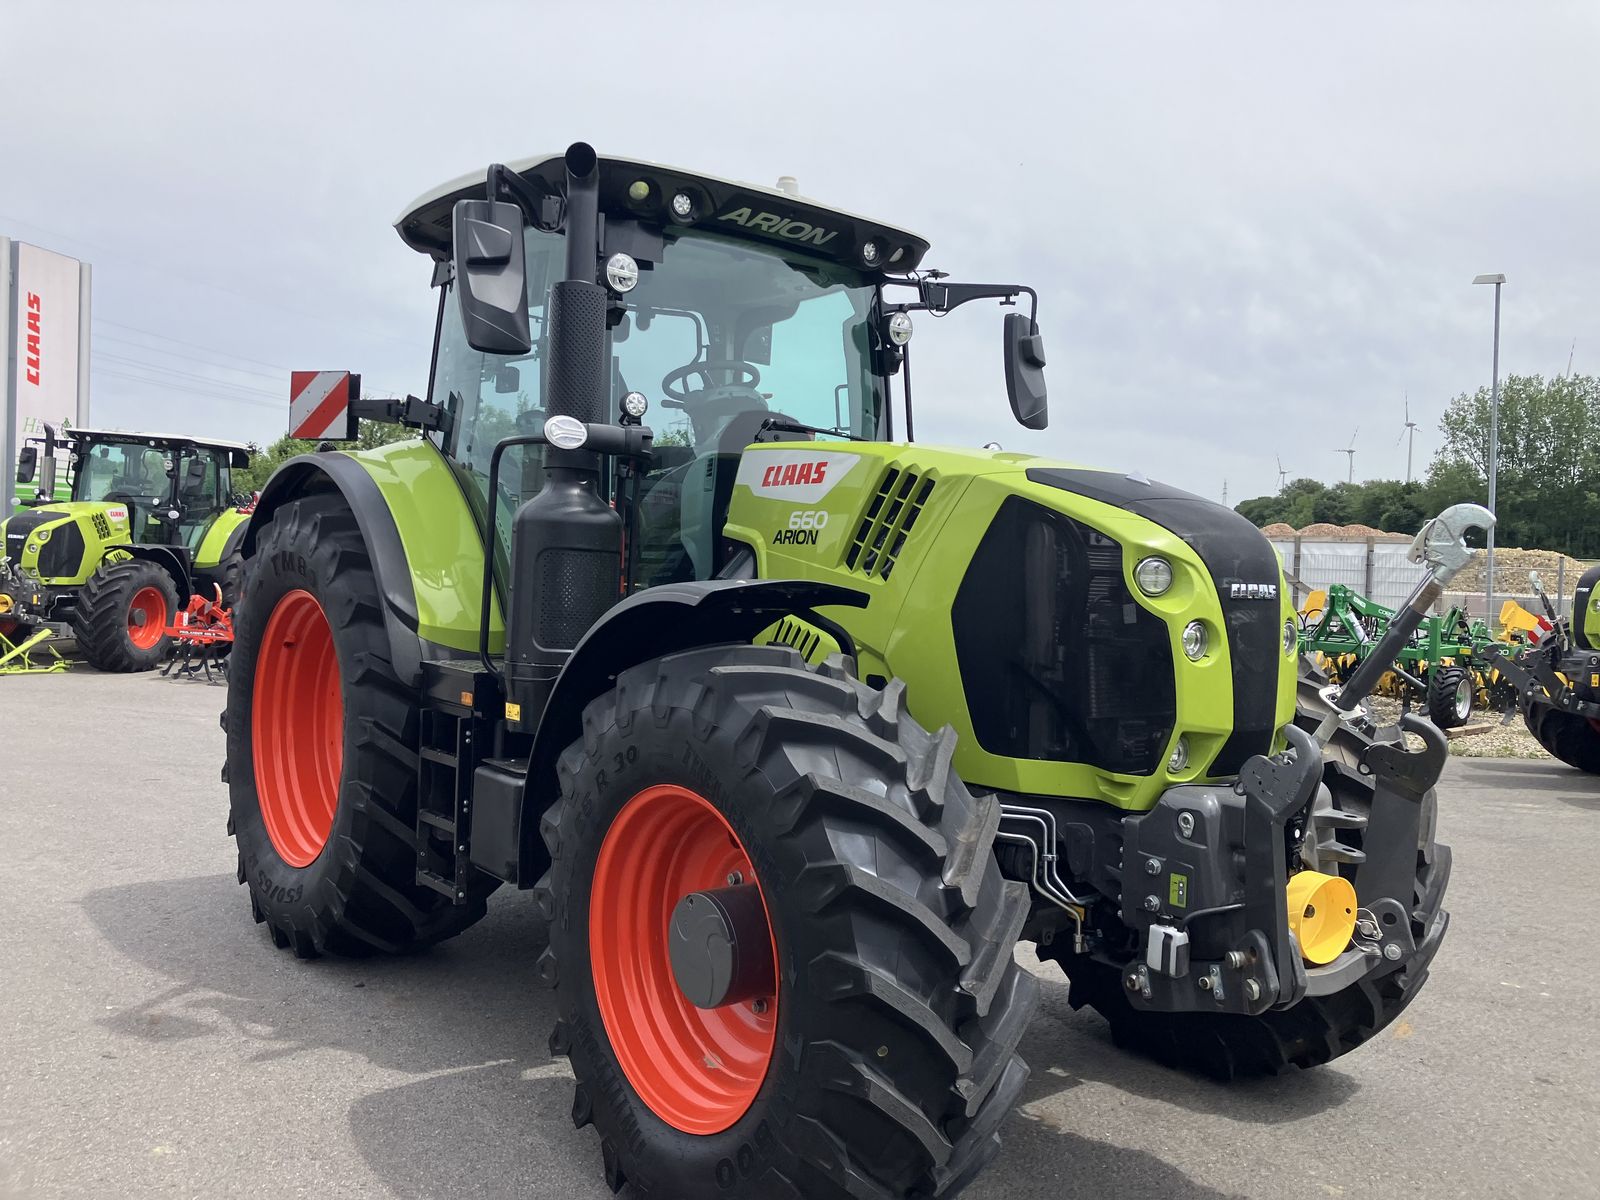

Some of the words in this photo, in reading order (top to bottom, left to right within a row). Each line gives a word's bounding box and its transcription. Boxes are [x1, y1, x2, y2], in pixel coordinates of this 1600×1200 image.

[718, 207, 838, 246] ARION
[27, 291, 41, 386] CLAAS
[762, 462, 828, 487] CLAAS
[789, 511, 829, 529] 660
[773, 530, 819, 545] ARION
